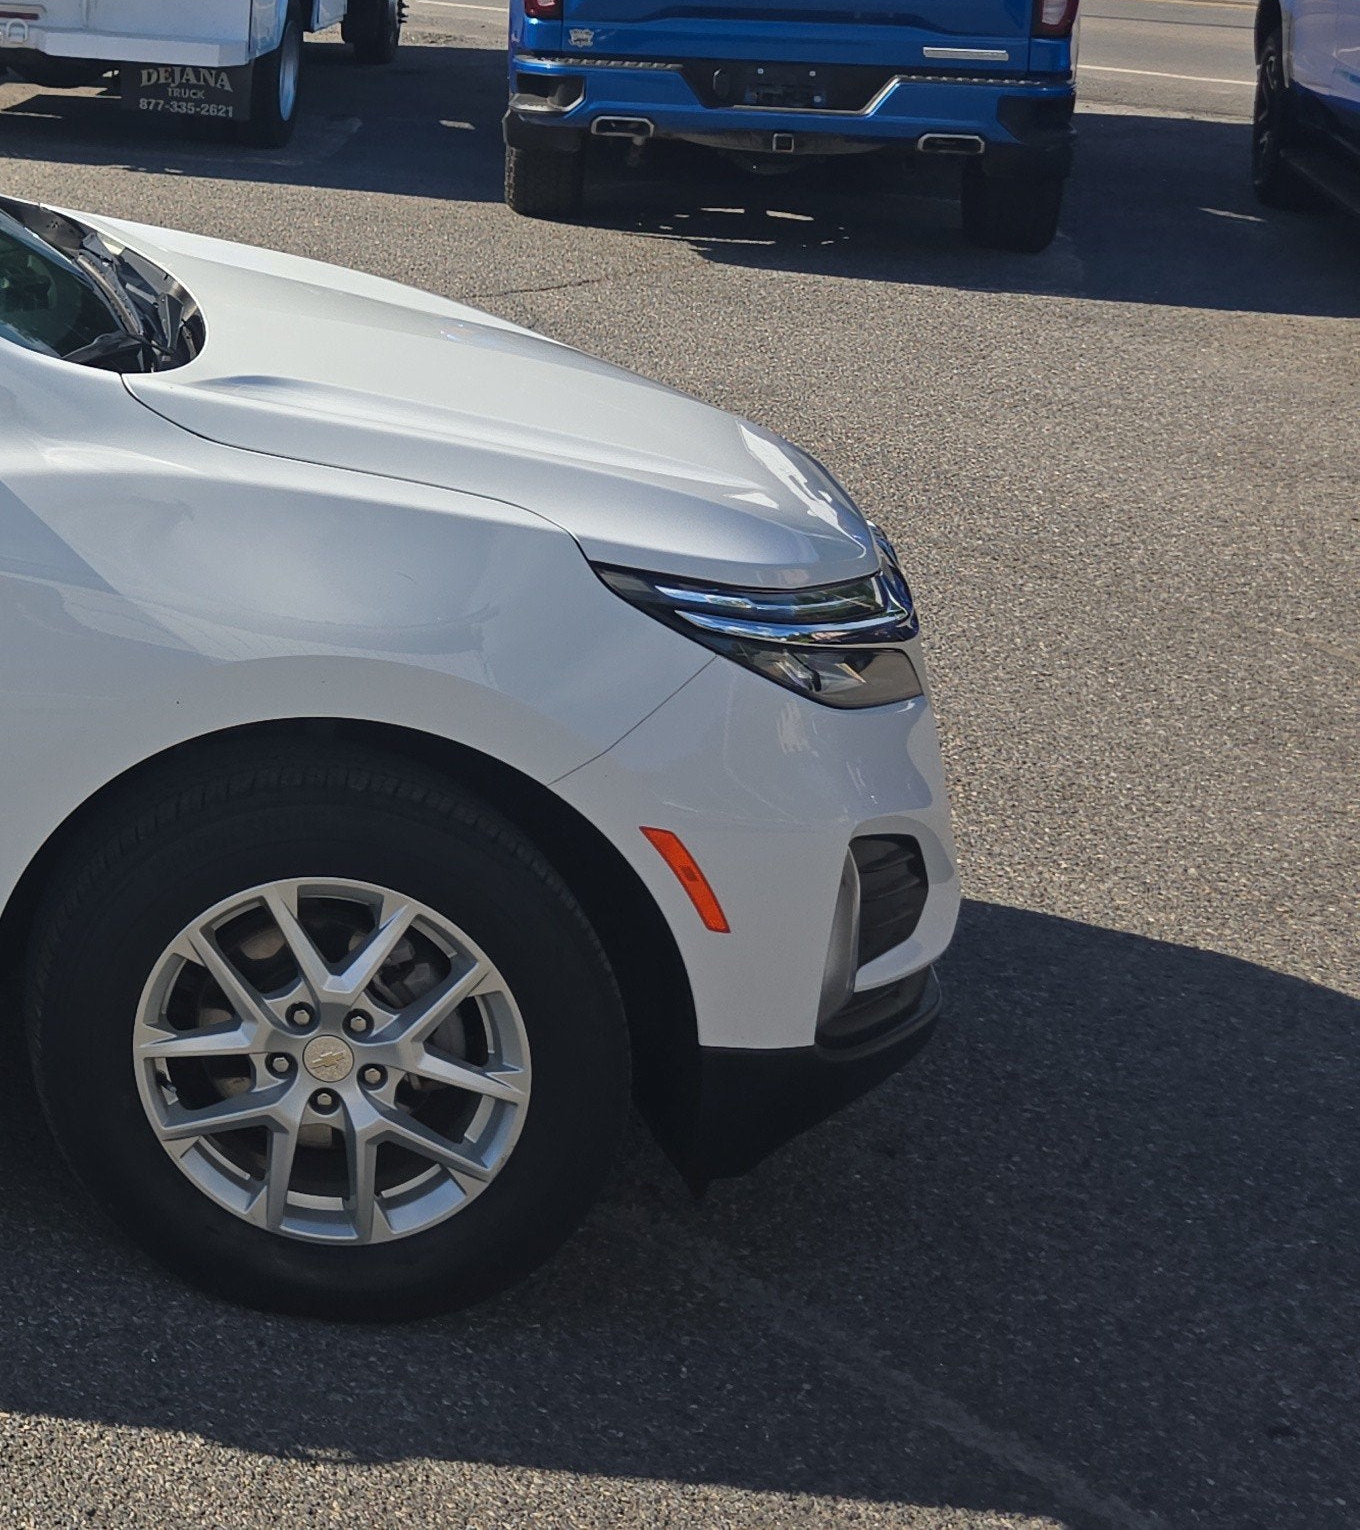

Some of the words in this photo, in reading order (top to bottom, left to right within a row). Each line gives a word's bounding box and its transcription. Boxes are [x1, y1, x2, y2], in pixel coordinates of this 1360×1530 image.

[140, 67, 233, 92] DEJANA
[167, 87, 205, 99] TRUCK
[140, 98, 233, 117] 877-335-2621
